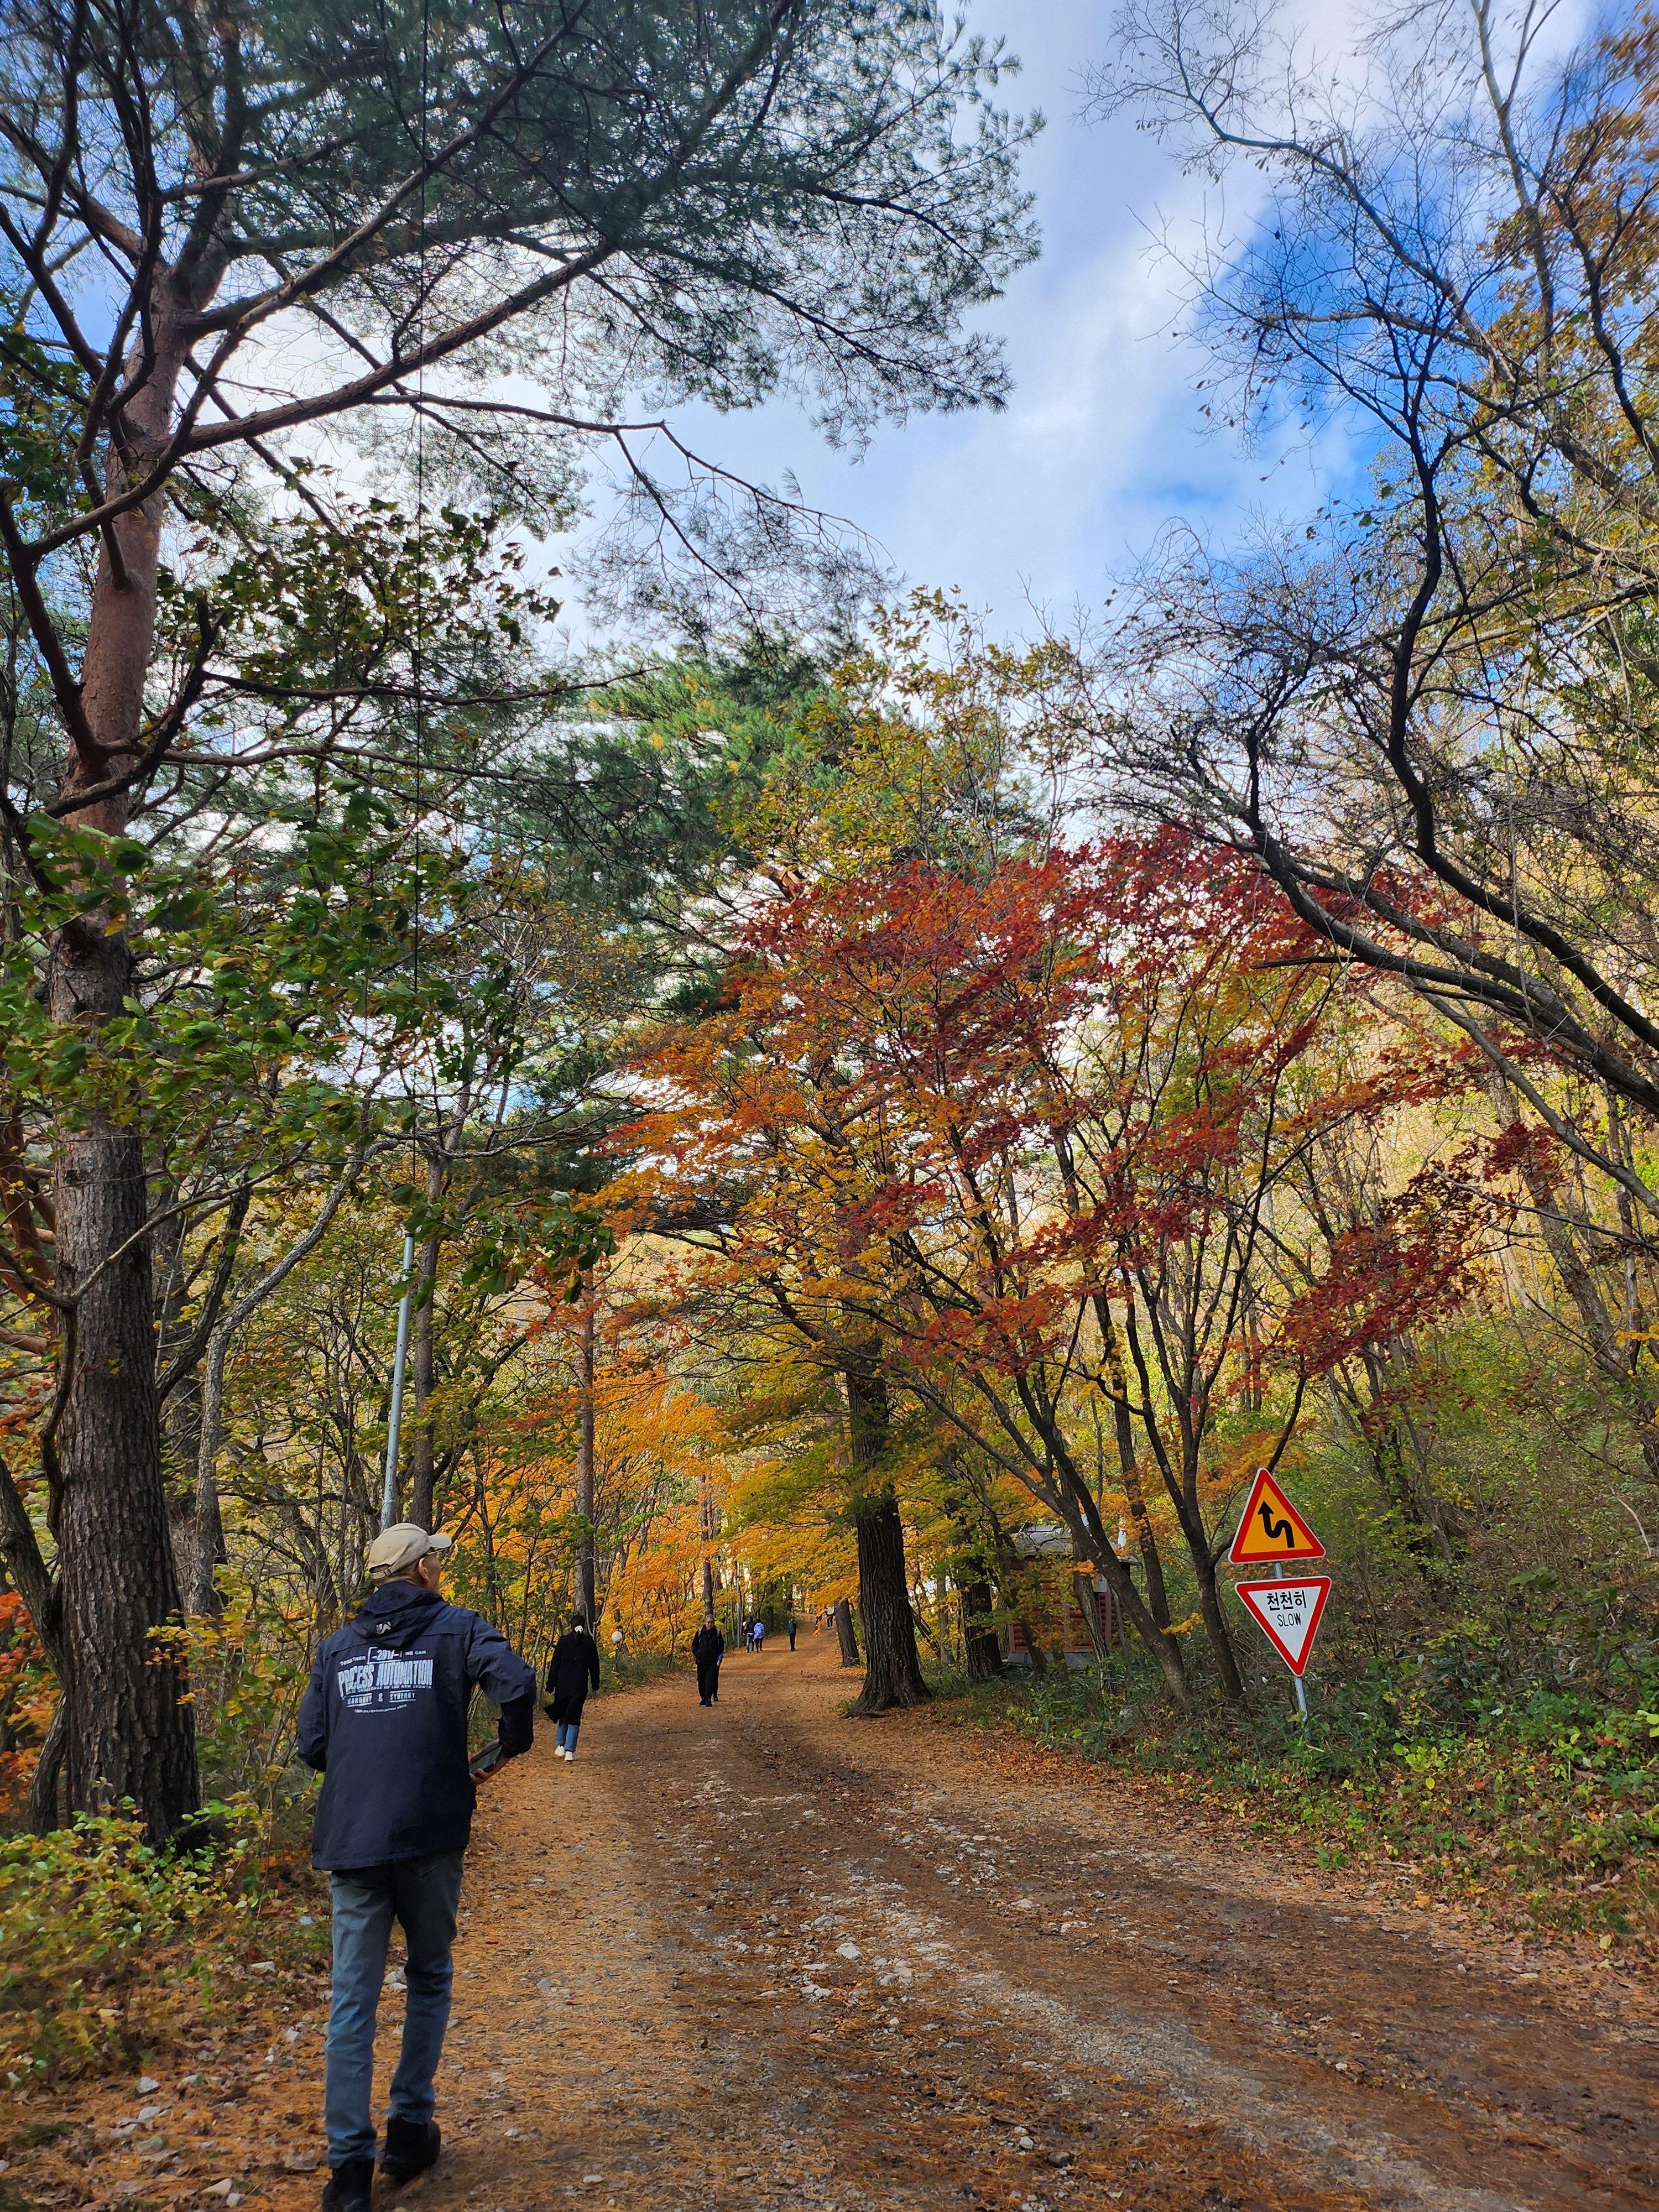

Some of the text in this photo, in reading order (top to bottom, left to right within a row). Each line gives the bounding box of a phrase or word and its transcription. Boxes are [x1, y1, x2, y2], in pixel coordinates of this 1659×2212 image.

[1266, 1590, 1307, 1611] 천천히
[1277, 1613, 1301, 1627] SLOW
[376, 1659, 434, 1687] AUTOMATION
[389, 1692, 416, 1700] SYNERGY
